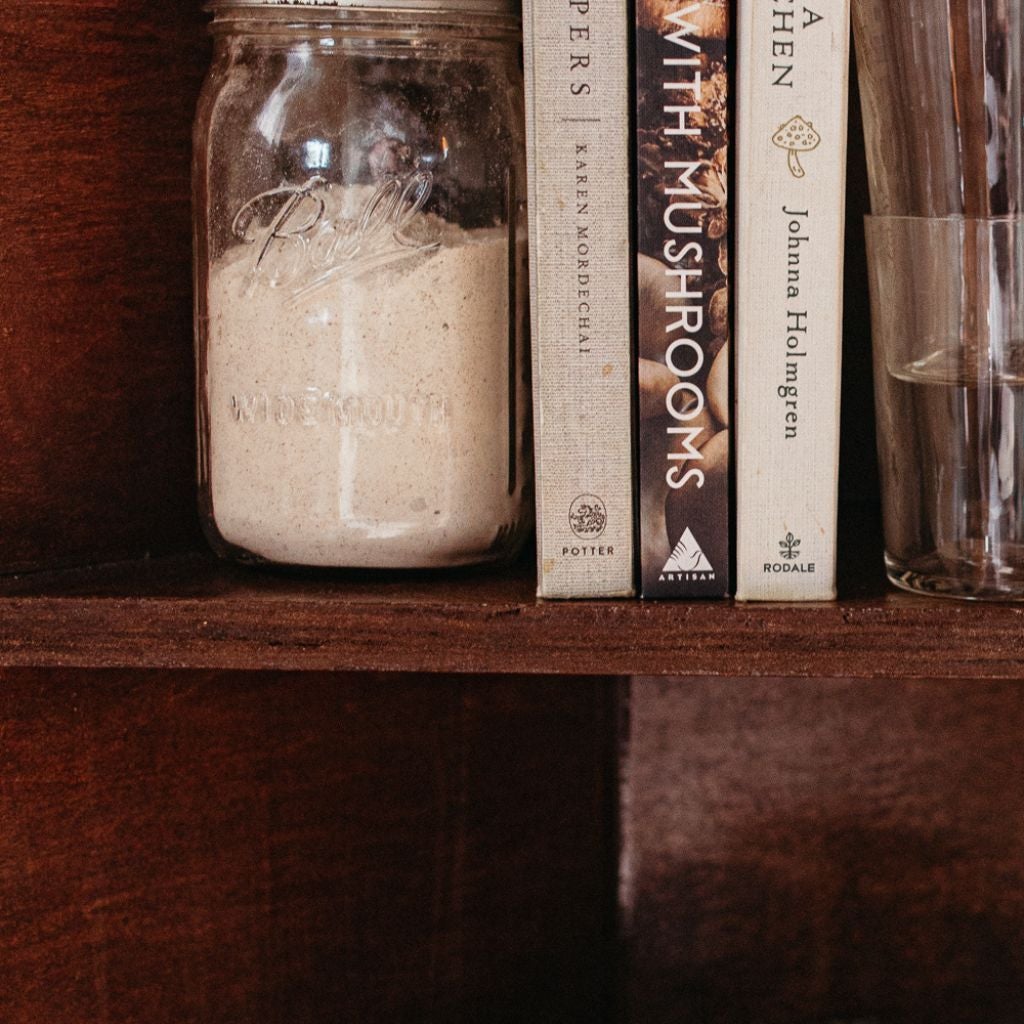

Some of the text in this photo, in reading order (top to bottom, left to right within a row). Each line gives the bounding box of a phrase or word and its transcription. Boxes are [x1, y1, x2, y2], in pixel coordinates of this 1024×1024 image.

[771, 0, 795, 88] HEN
[802, 7, 824, 29] A
[575, 145, 591, 354] KAREN MORDECHAI
[663, 3, 705, 490] WITH MUSHROOMS
[777, 205, 810, 440] Johnna Holmgren
[562, 546, 614, 556] POTTER
[658, 573, 715, 581] ARTISAN
[763, 562, 815, 573] RODALE
